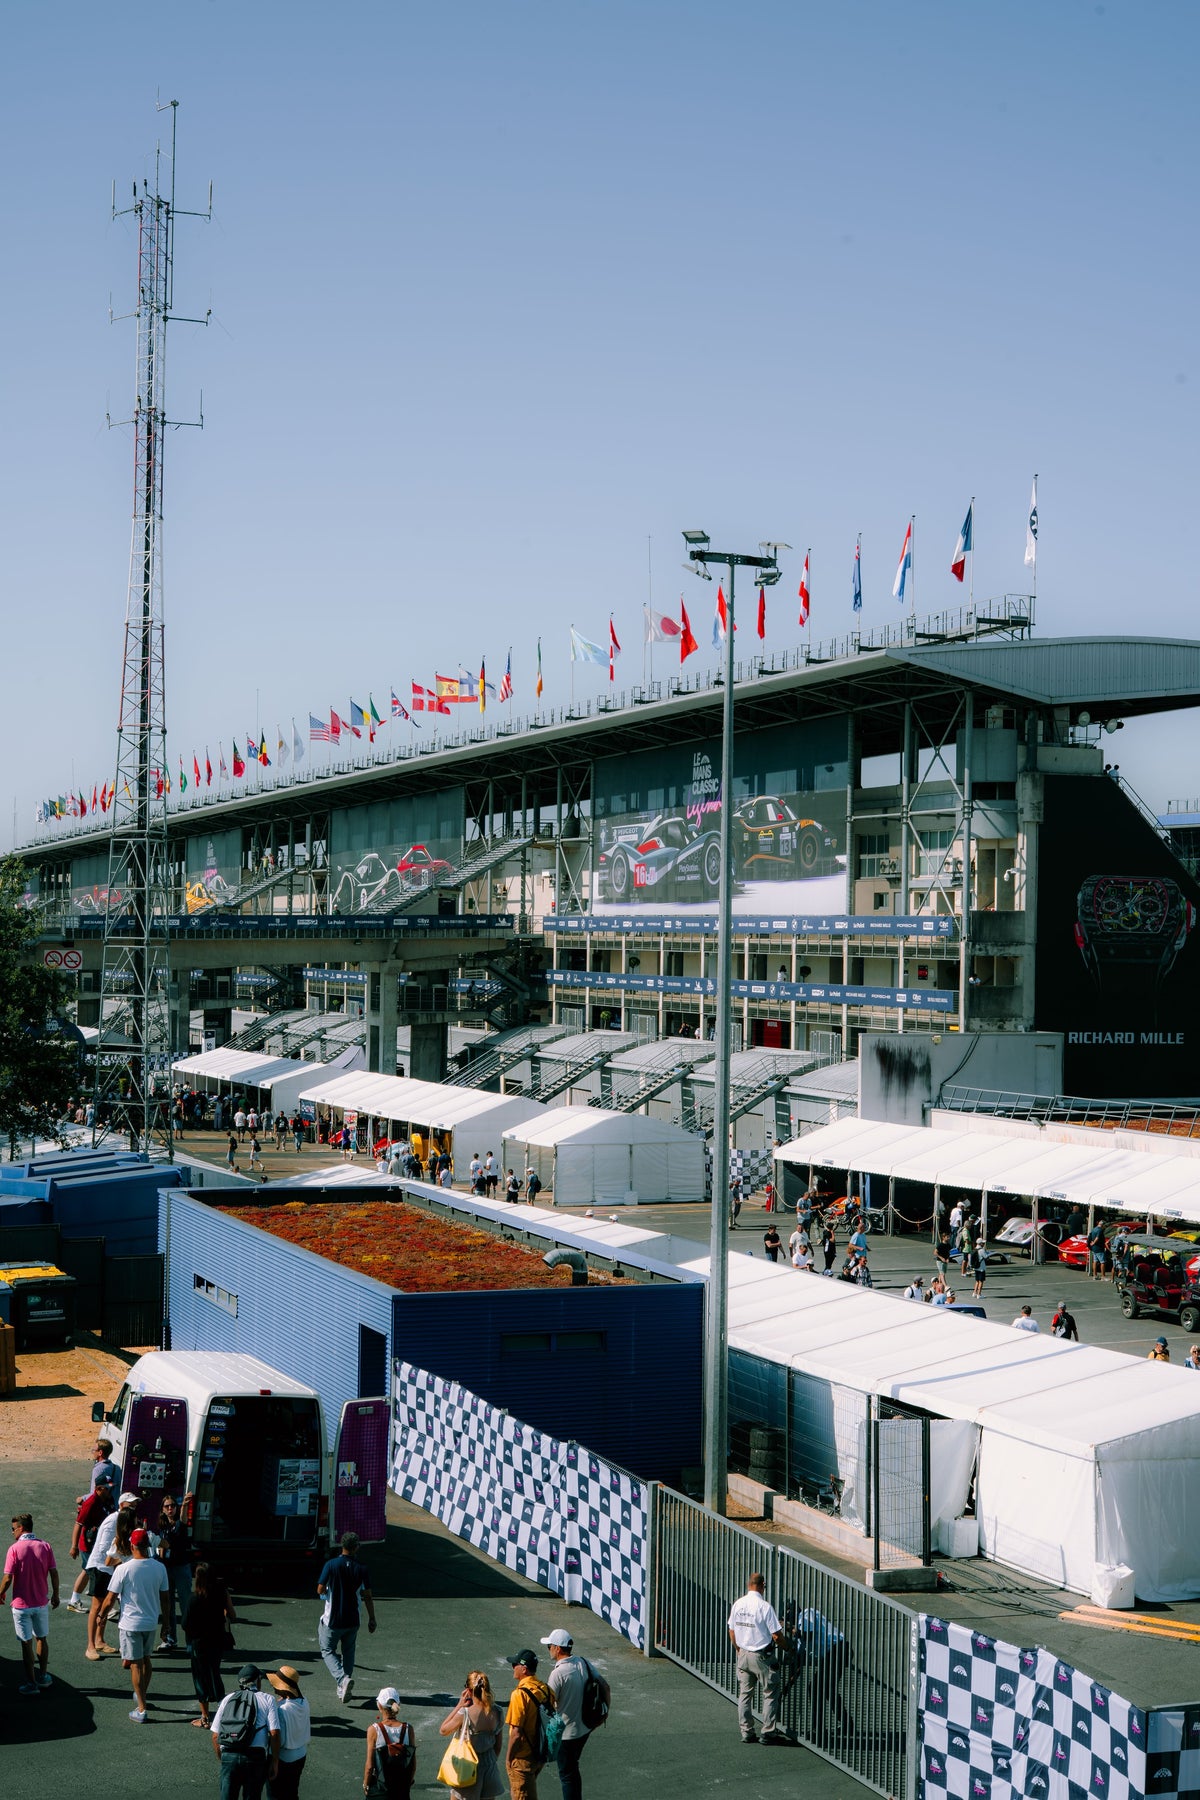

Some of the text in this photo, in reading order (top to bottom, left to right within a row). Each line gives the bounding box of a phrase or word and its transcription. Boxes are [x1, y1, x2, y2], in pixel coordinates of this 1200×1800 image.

[693, 752, 702, 766] LE
[692, 764, 712, 780] MANS
[692, 778, 719, 795] CLASSIC
[635, 865, 646, 885] 16
[1068, 1031, 1185, 1045] RICHARD MILLE
